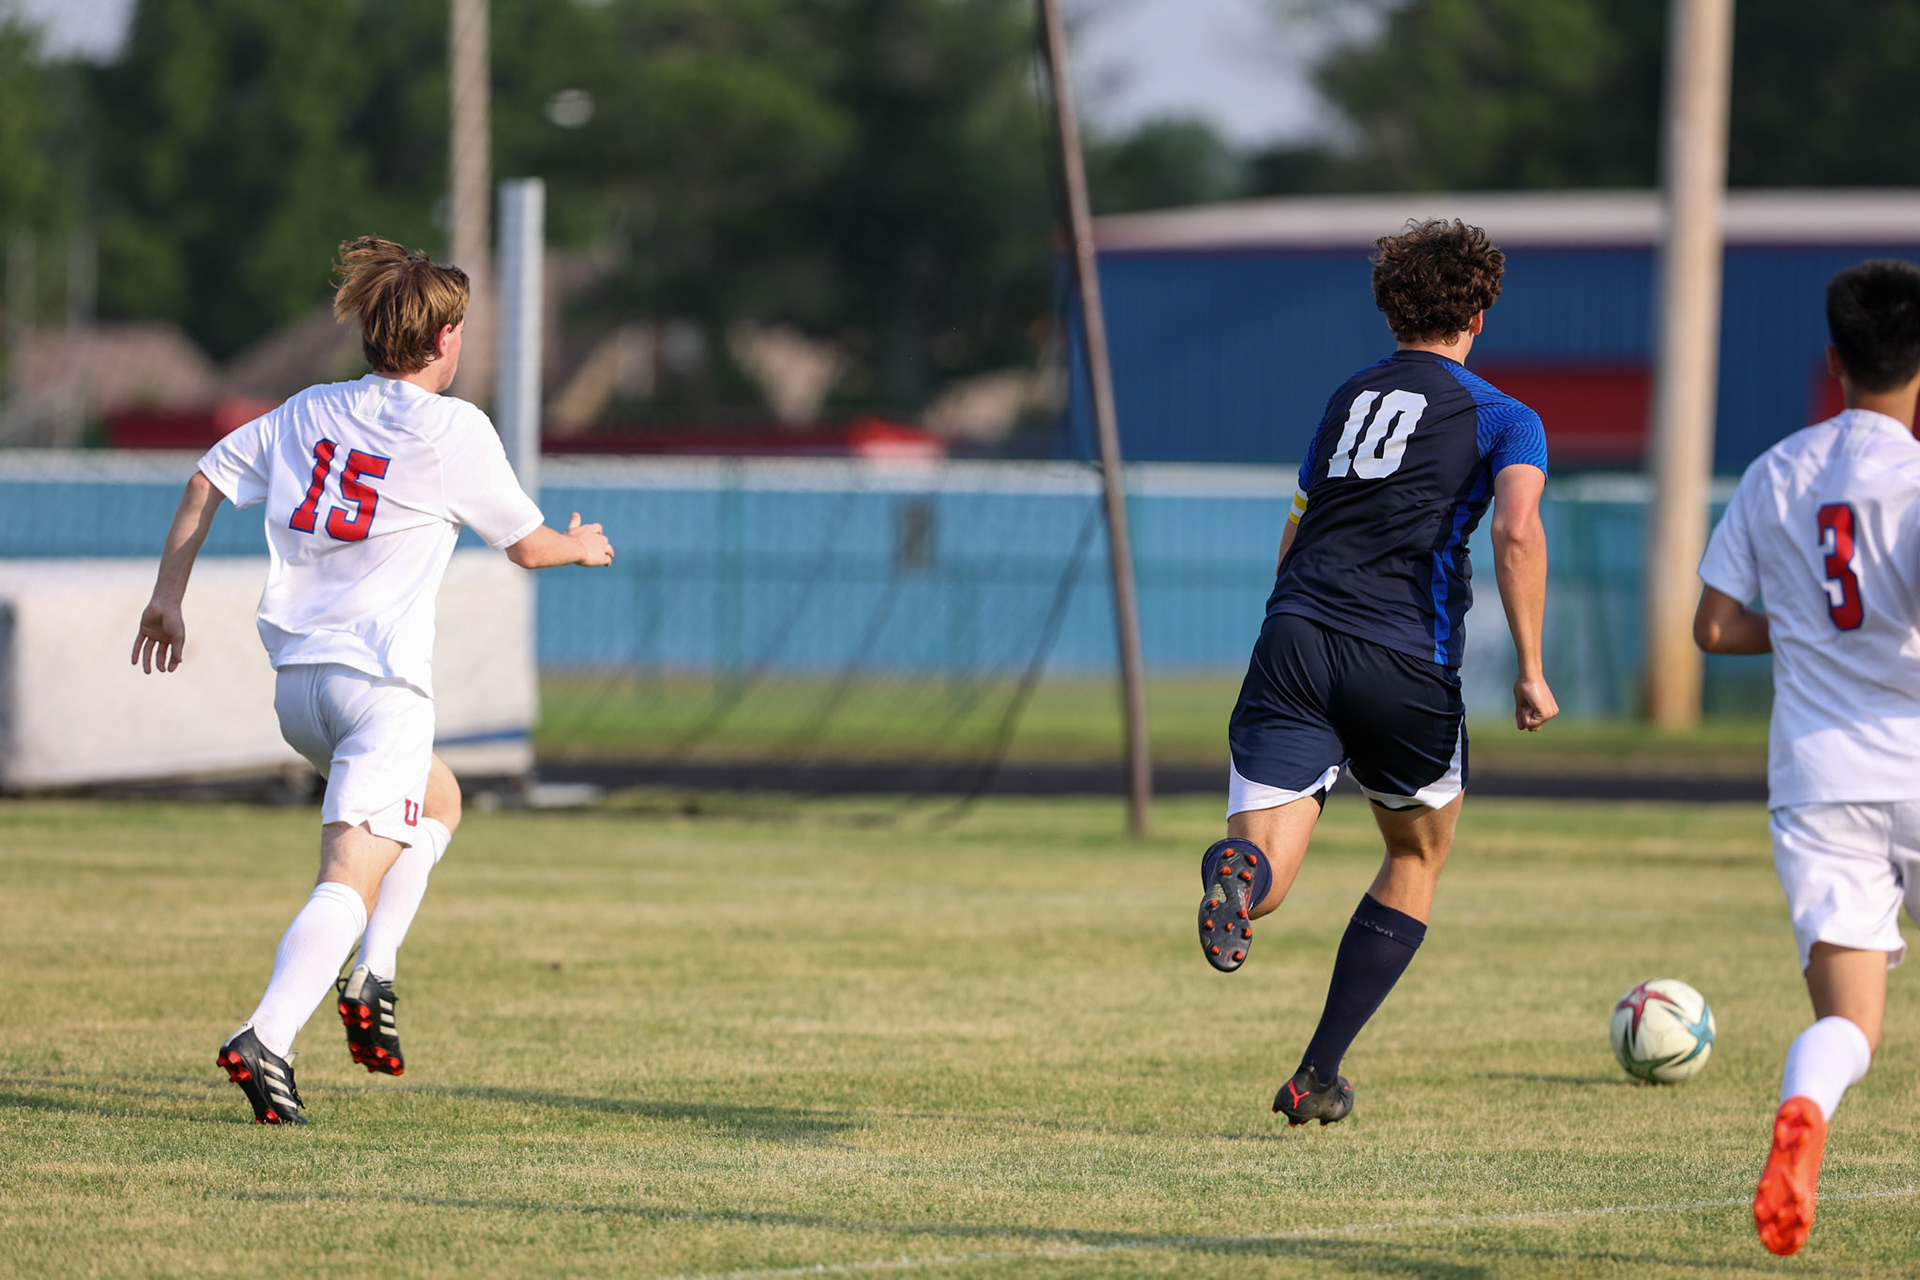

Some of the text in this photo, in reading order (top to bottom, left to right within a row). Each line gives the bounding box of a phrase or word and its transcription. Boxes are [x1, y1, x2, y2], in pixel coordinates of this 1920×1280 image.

[1327, 389, 1428, 479] 10
[289, 438, 391, 542] 15
[1817, 504, 1864, 631] 3
[404, 798, 419, 827] U
